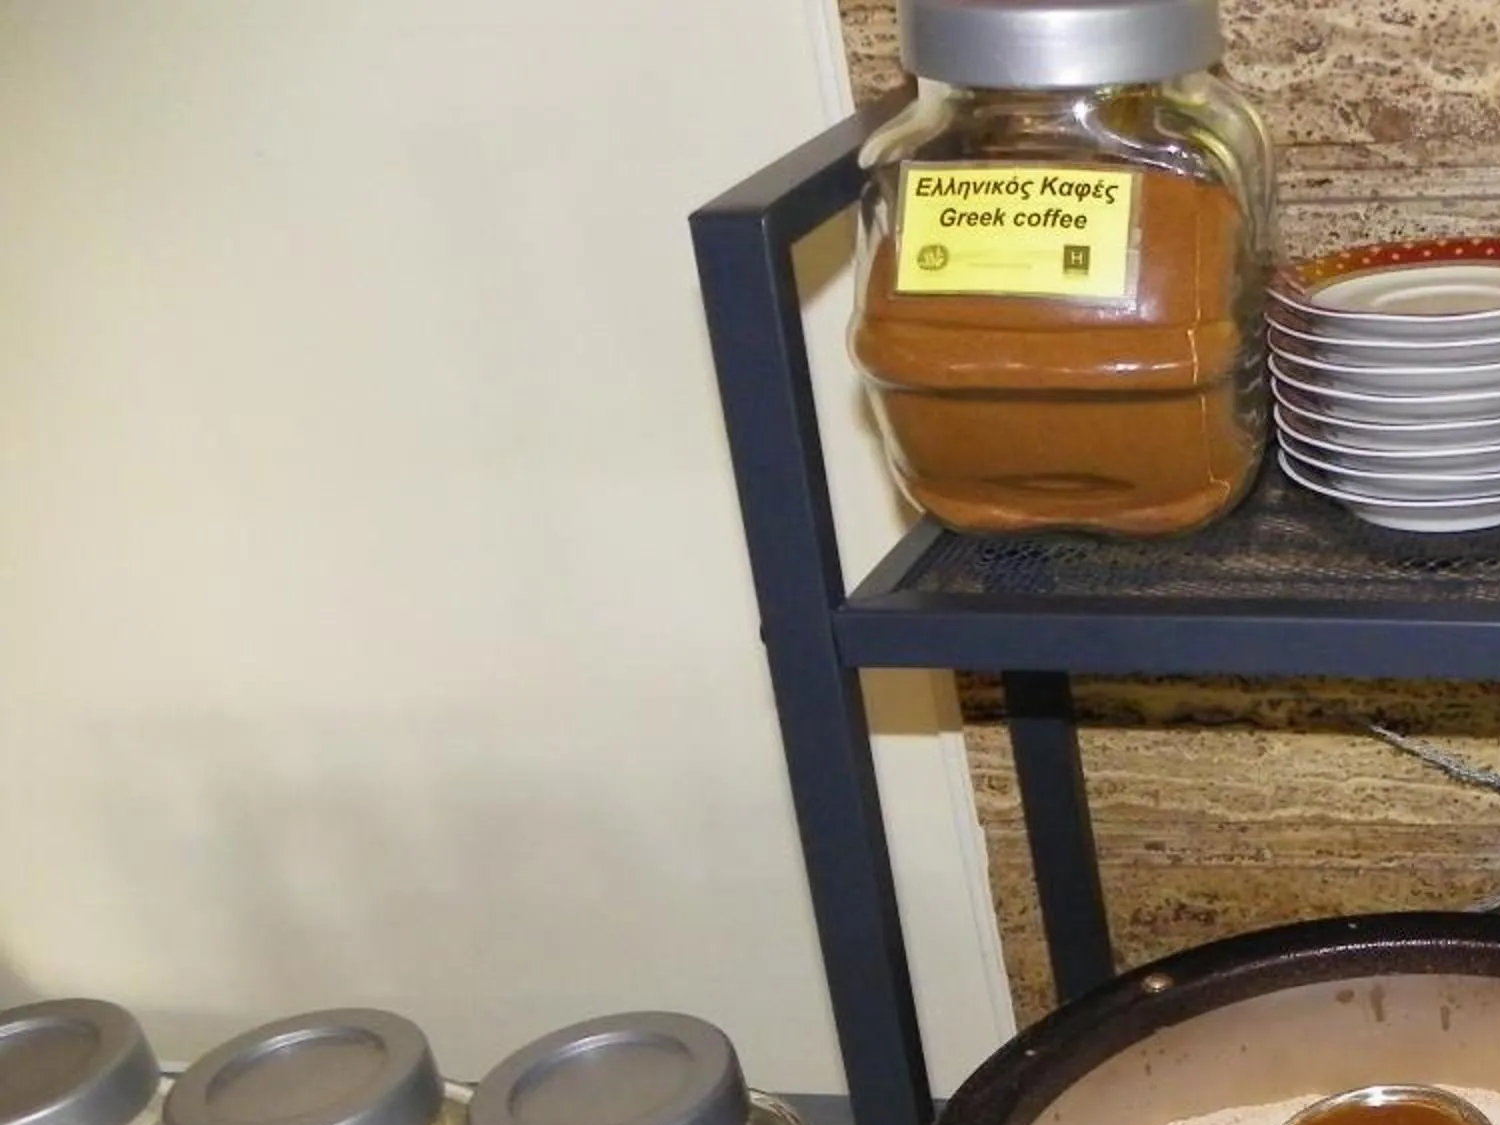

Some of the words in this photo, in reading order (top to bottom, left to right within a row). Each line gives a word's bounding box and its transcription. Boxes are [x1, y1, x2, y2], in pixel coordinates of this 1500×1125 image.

[914, 176, 1034, 200] Ελληνικός
[1040, 176, 1119, 204] Καφές
[939, 208, 1005, 228] Greek
[1013, 209, 1088, 229] coffee
